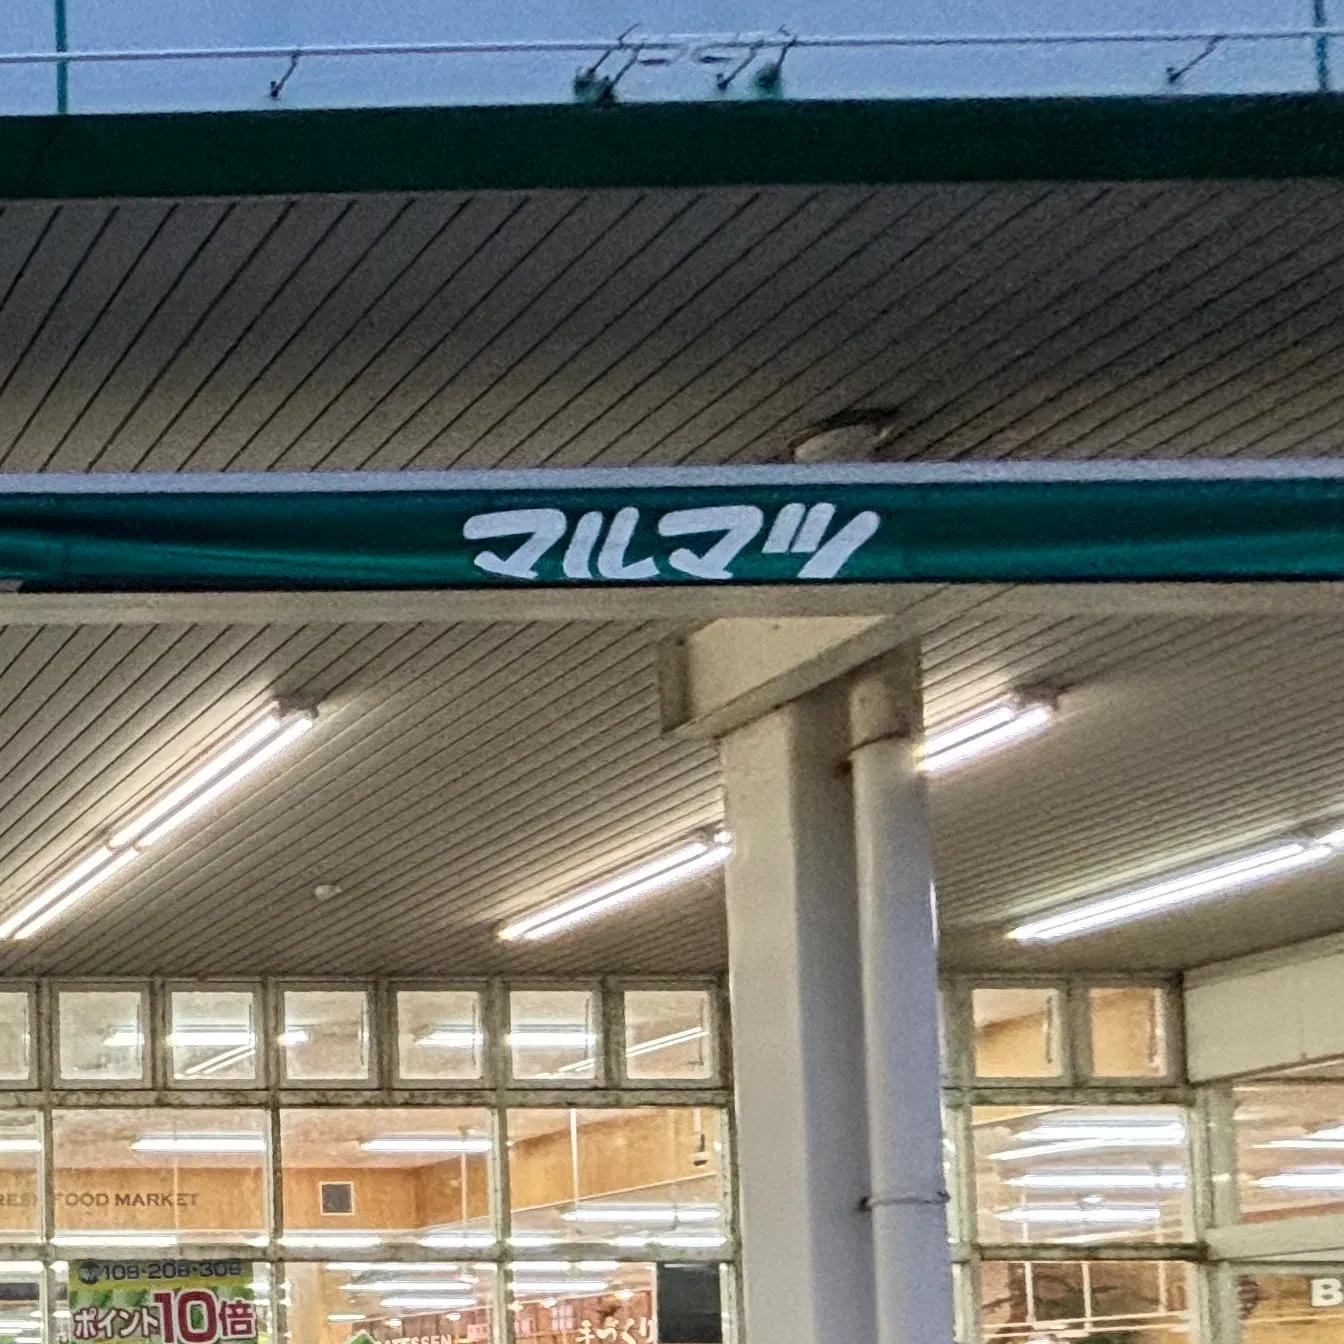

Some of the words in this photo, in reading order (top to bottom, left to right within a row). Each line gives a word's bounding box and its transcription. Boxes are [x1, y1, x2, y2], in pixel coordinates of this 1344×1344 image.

[463, 502, 881, 580] マルマツ
[115, 1193, 198, 1206] MARKET
